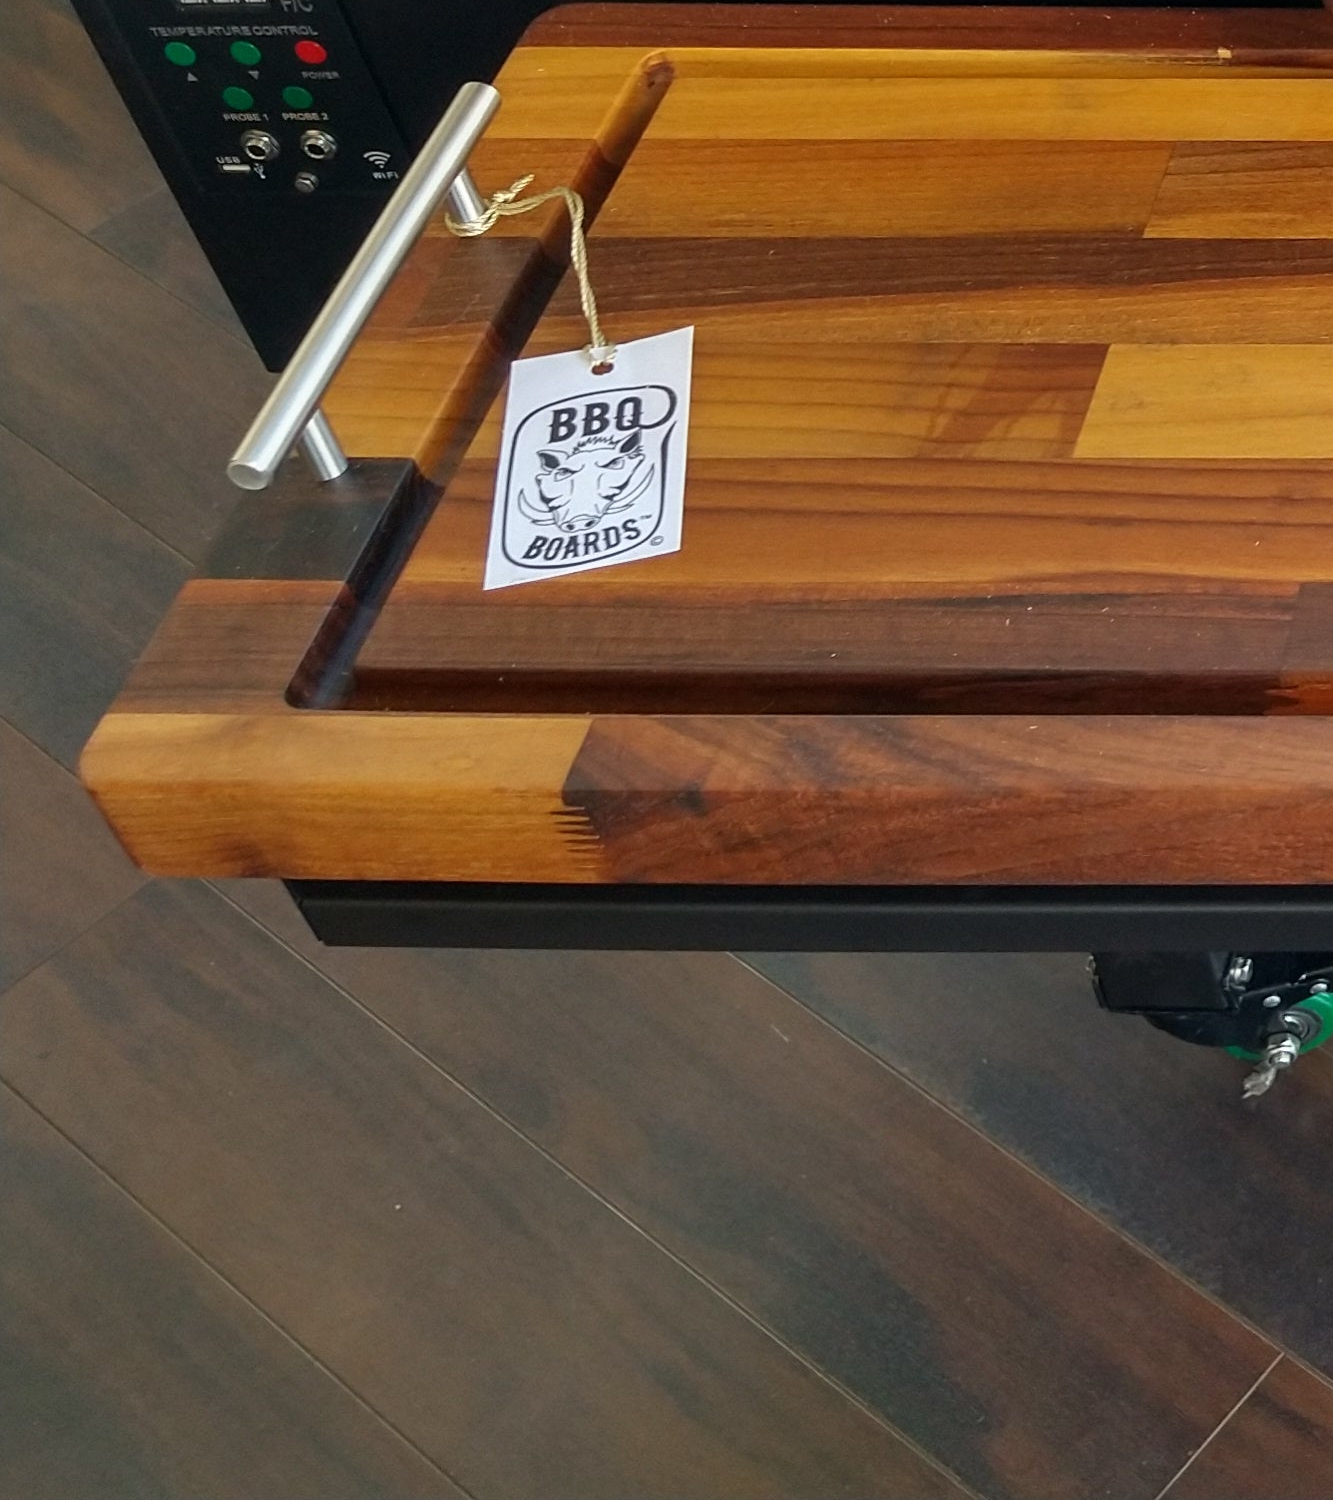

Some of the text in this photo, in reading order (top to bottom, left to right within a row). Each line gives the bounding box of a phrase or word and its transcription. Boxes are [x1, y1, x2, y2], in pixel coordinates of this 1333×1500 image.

[150, 25, 318, 37] TEMPERATURE CONTROL
[302, 71, 339, 80] POWER
[223, 113, 269, 122] PROBE 1
[282, 113, 319, 121] PROBE
[216, 156, 241, 164] USB
[547, 396, 645, 445] BBQ
[522, 518, 641, 561] BOARDS
